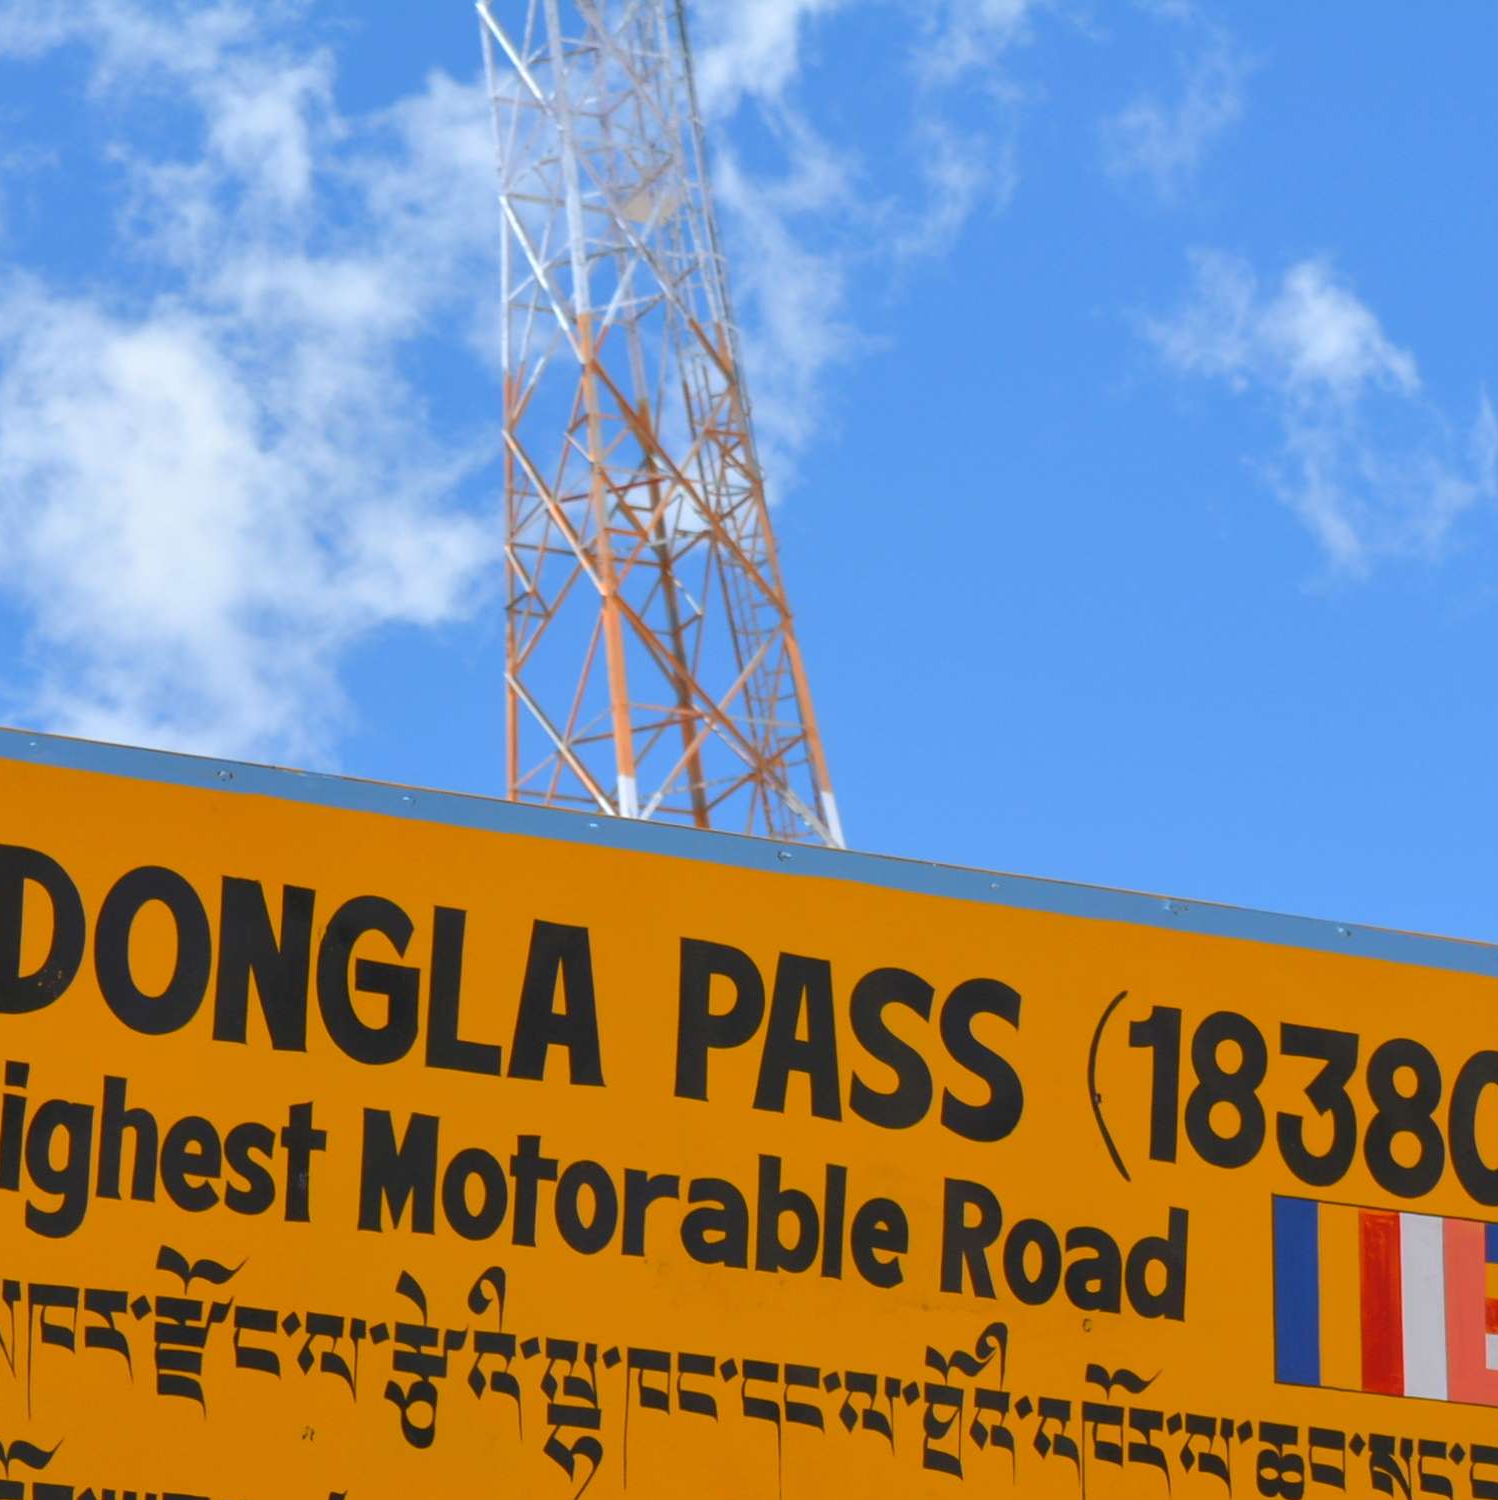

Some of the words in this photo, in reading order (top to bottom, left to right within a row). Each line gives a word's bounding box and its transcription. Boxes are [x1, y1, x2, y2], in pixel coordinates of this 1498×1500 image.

[675, 937, 1024, 1142] PASS
[358, 1108, 910, 1290] Motorable
[941, 1178, 1189, 1321] Road
